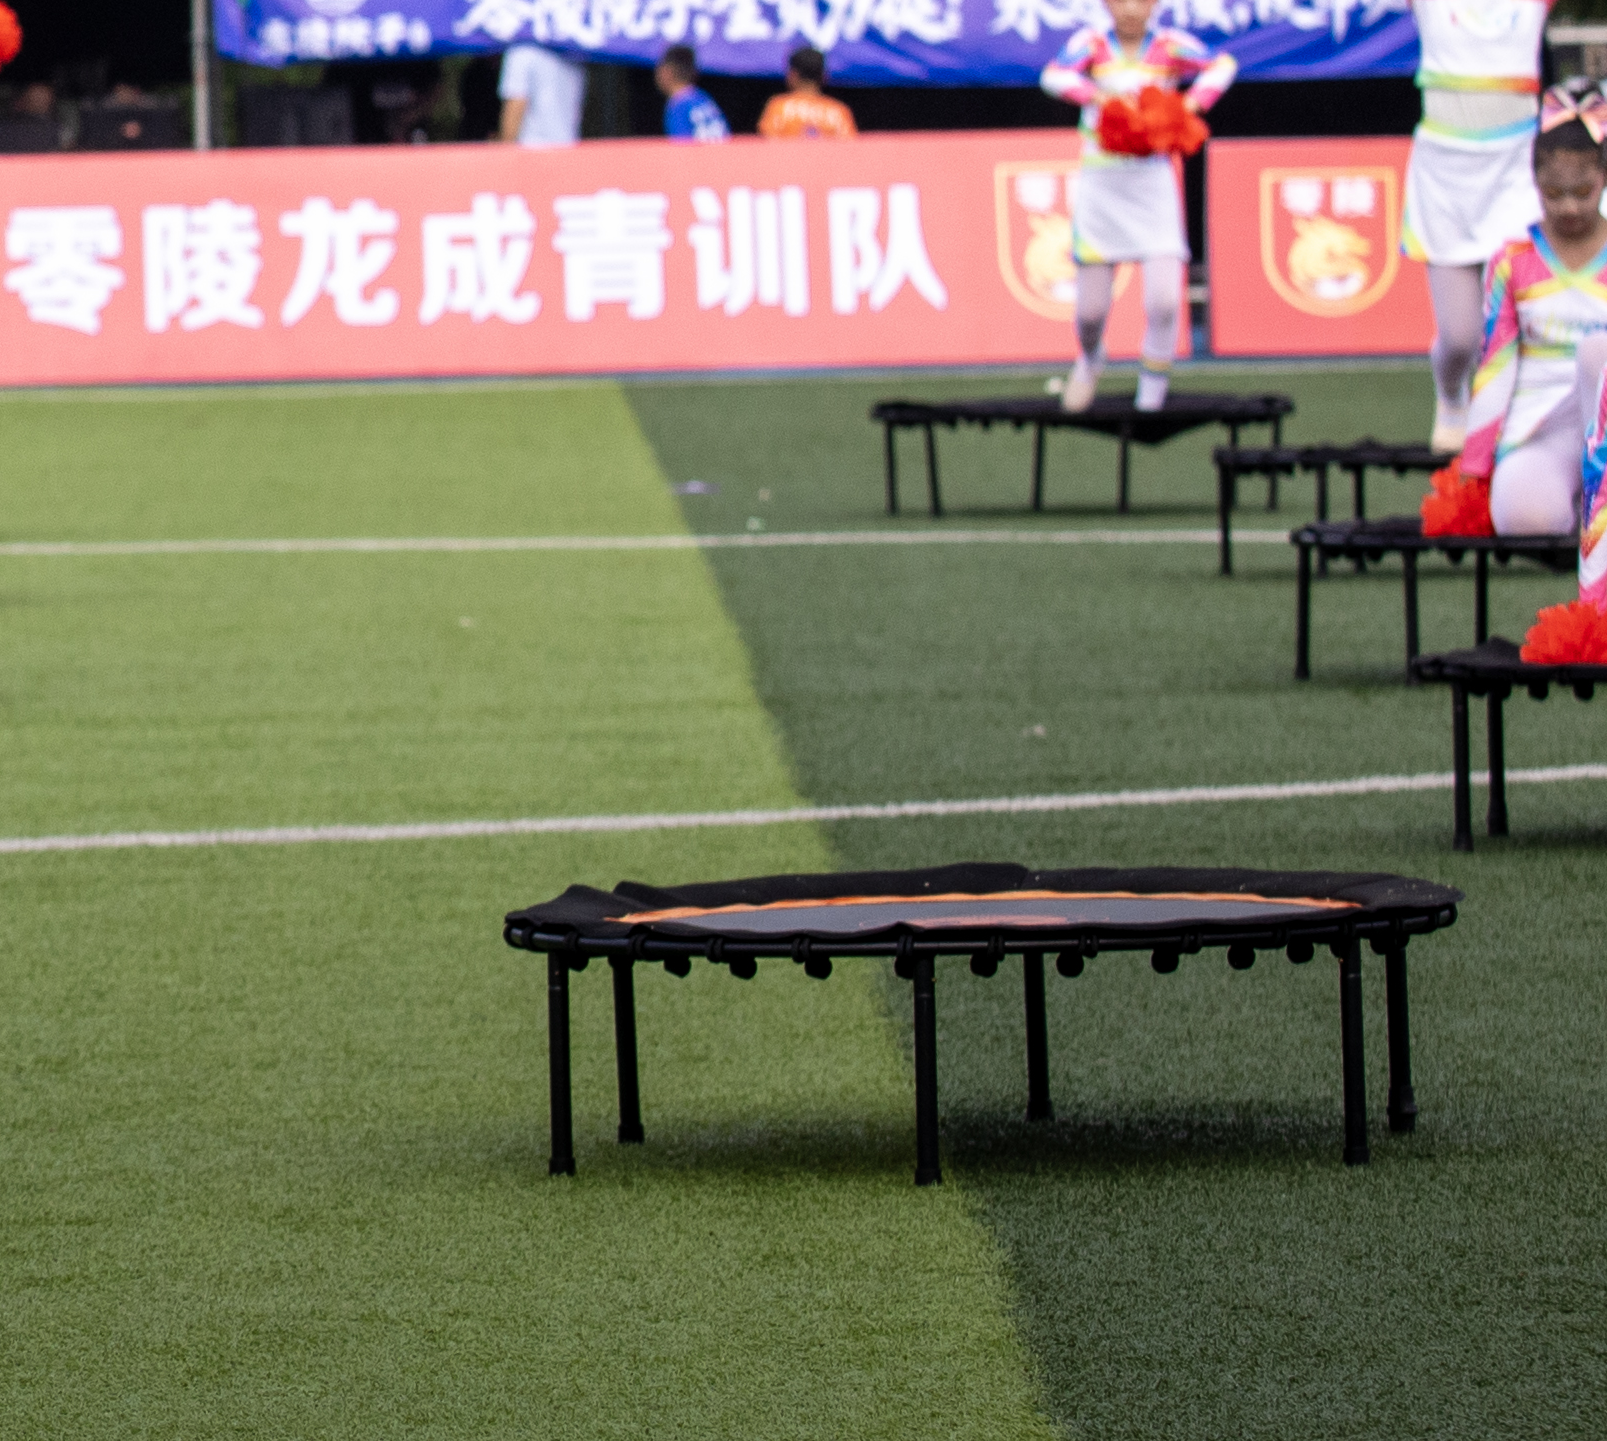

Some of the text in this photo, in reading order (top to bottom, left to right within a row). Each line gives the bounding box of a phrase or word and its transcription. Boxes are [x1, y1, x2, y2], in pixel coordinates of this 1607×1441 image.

[3, 184, 949, 334] 零陵龙成青训队
